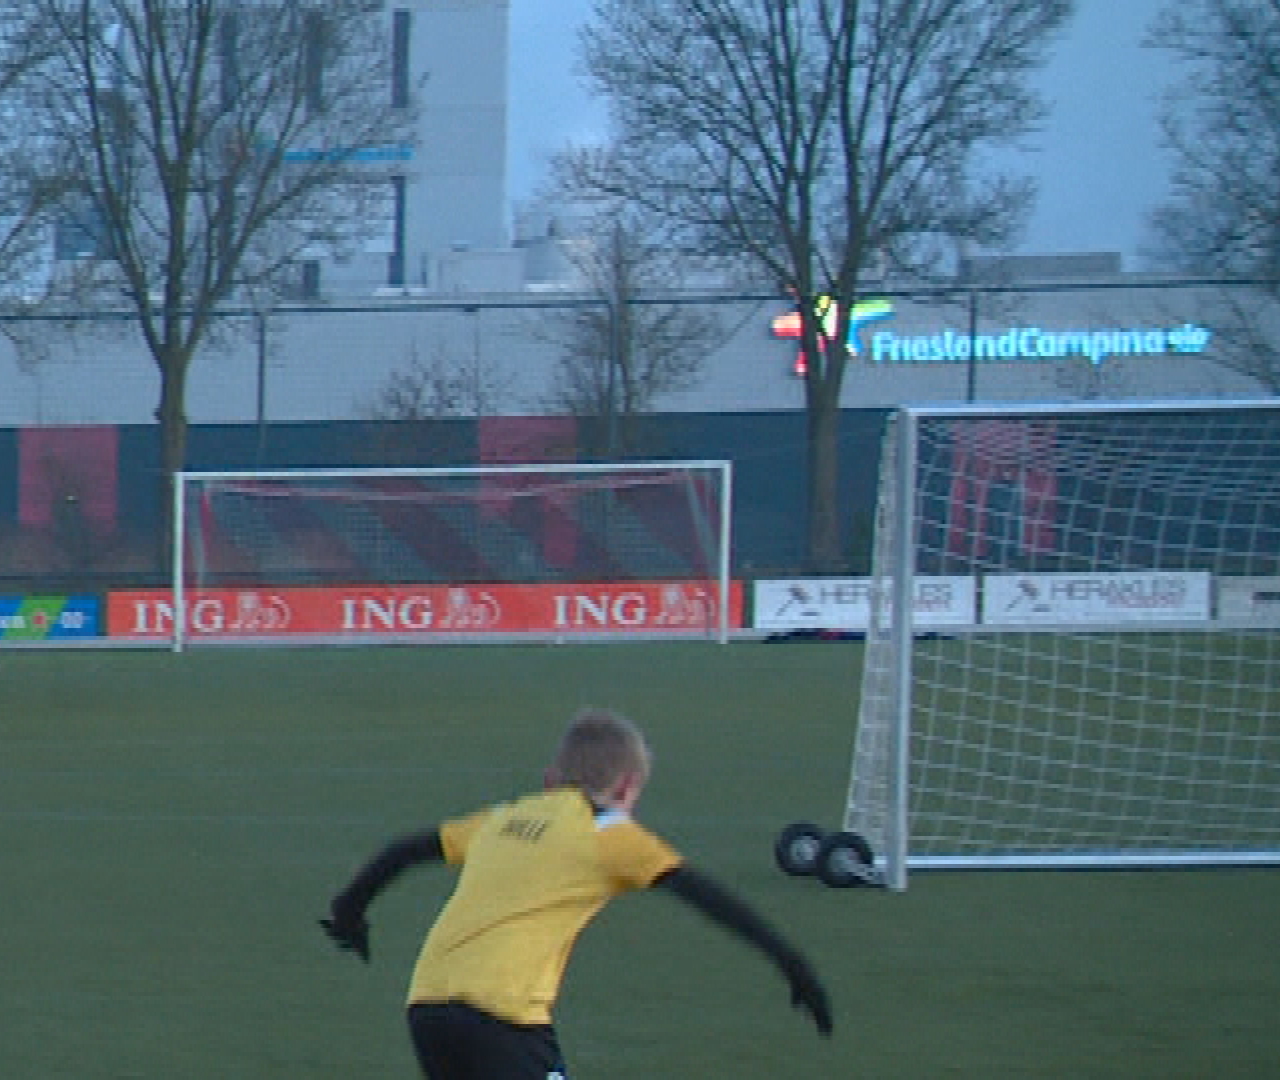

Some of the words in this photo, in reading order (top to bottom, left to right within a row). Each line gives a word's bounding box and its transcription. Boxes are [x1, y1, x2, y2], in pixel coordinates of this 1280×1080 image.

[871, 328, 1166, 365] FrieslandCampina
[132, 599, 225, 633] ING
[343, 596, 434, 629] ING
[554, 592, 648, 626] ING
